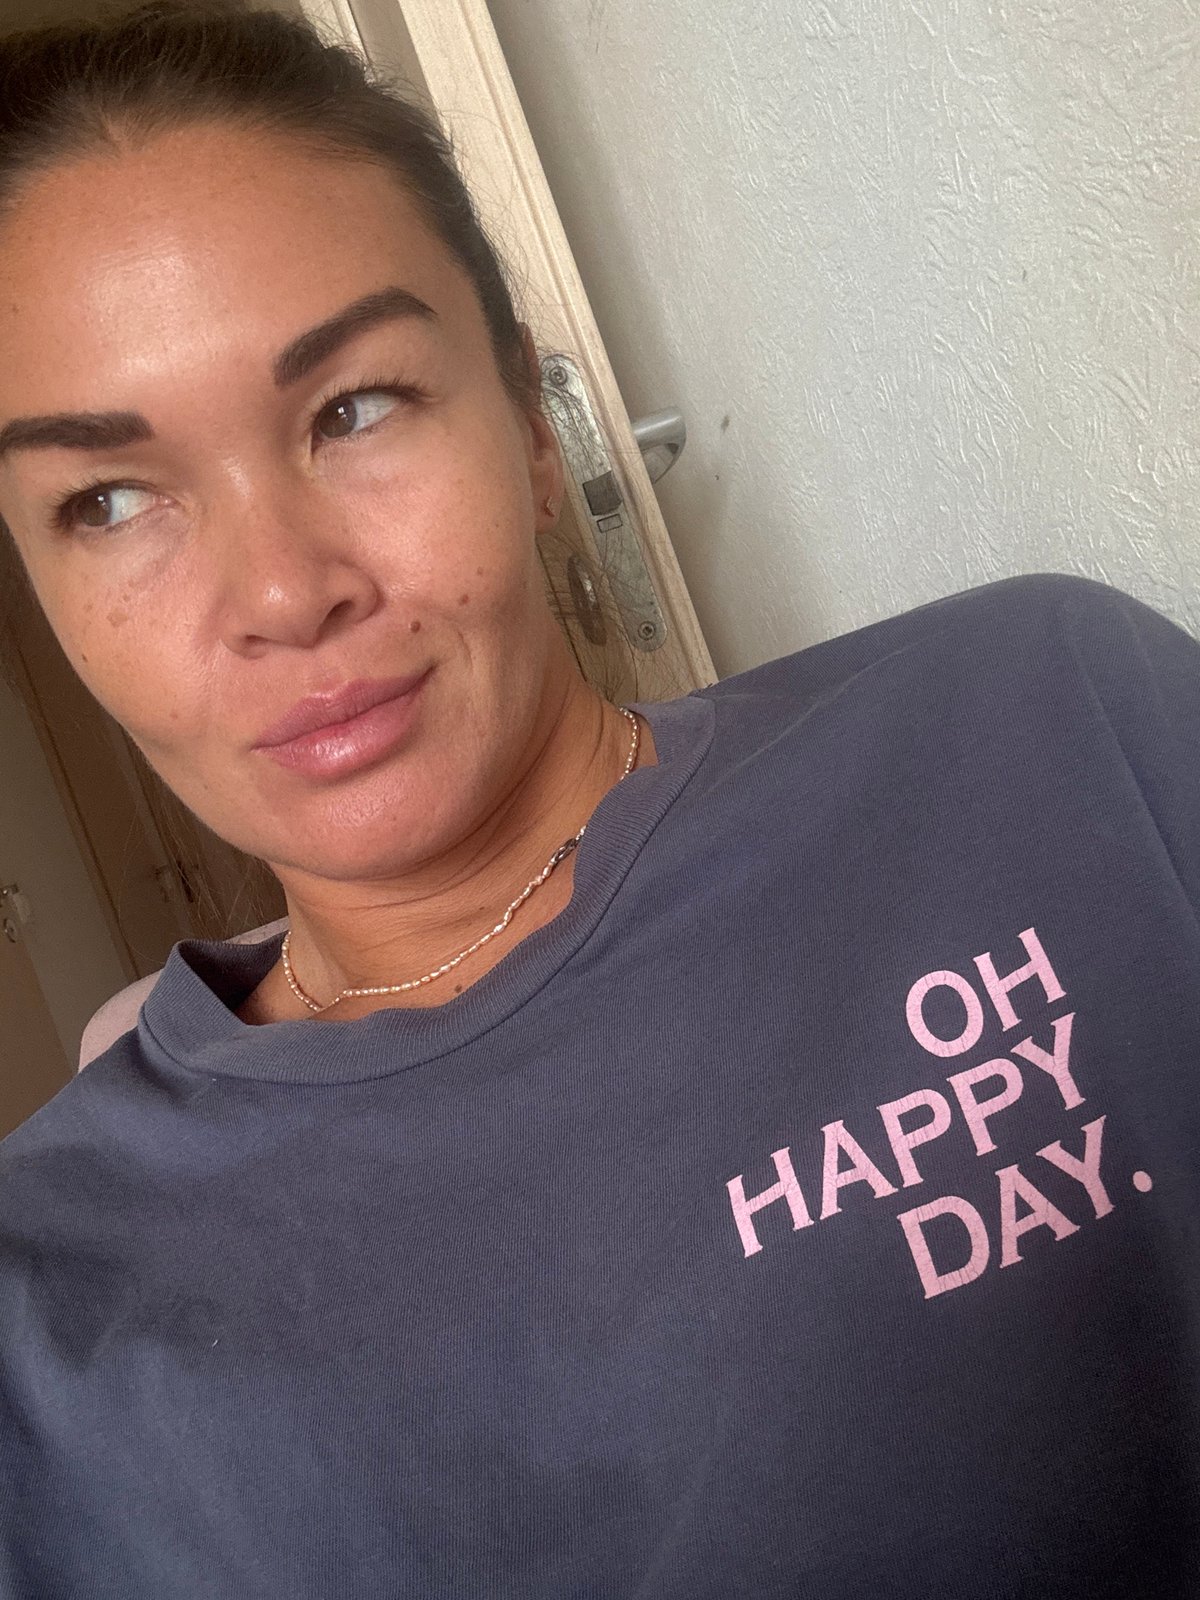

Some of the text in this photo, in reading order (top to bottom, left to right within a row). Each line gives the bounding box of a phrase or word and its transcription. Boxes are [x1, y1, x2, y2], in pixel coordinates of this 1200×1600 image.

[905, 927, 1067, 1058] OH
[725, 1012, 1086, 1258] HAPPY
[896, 1115, 1152, 1299] DAY.
